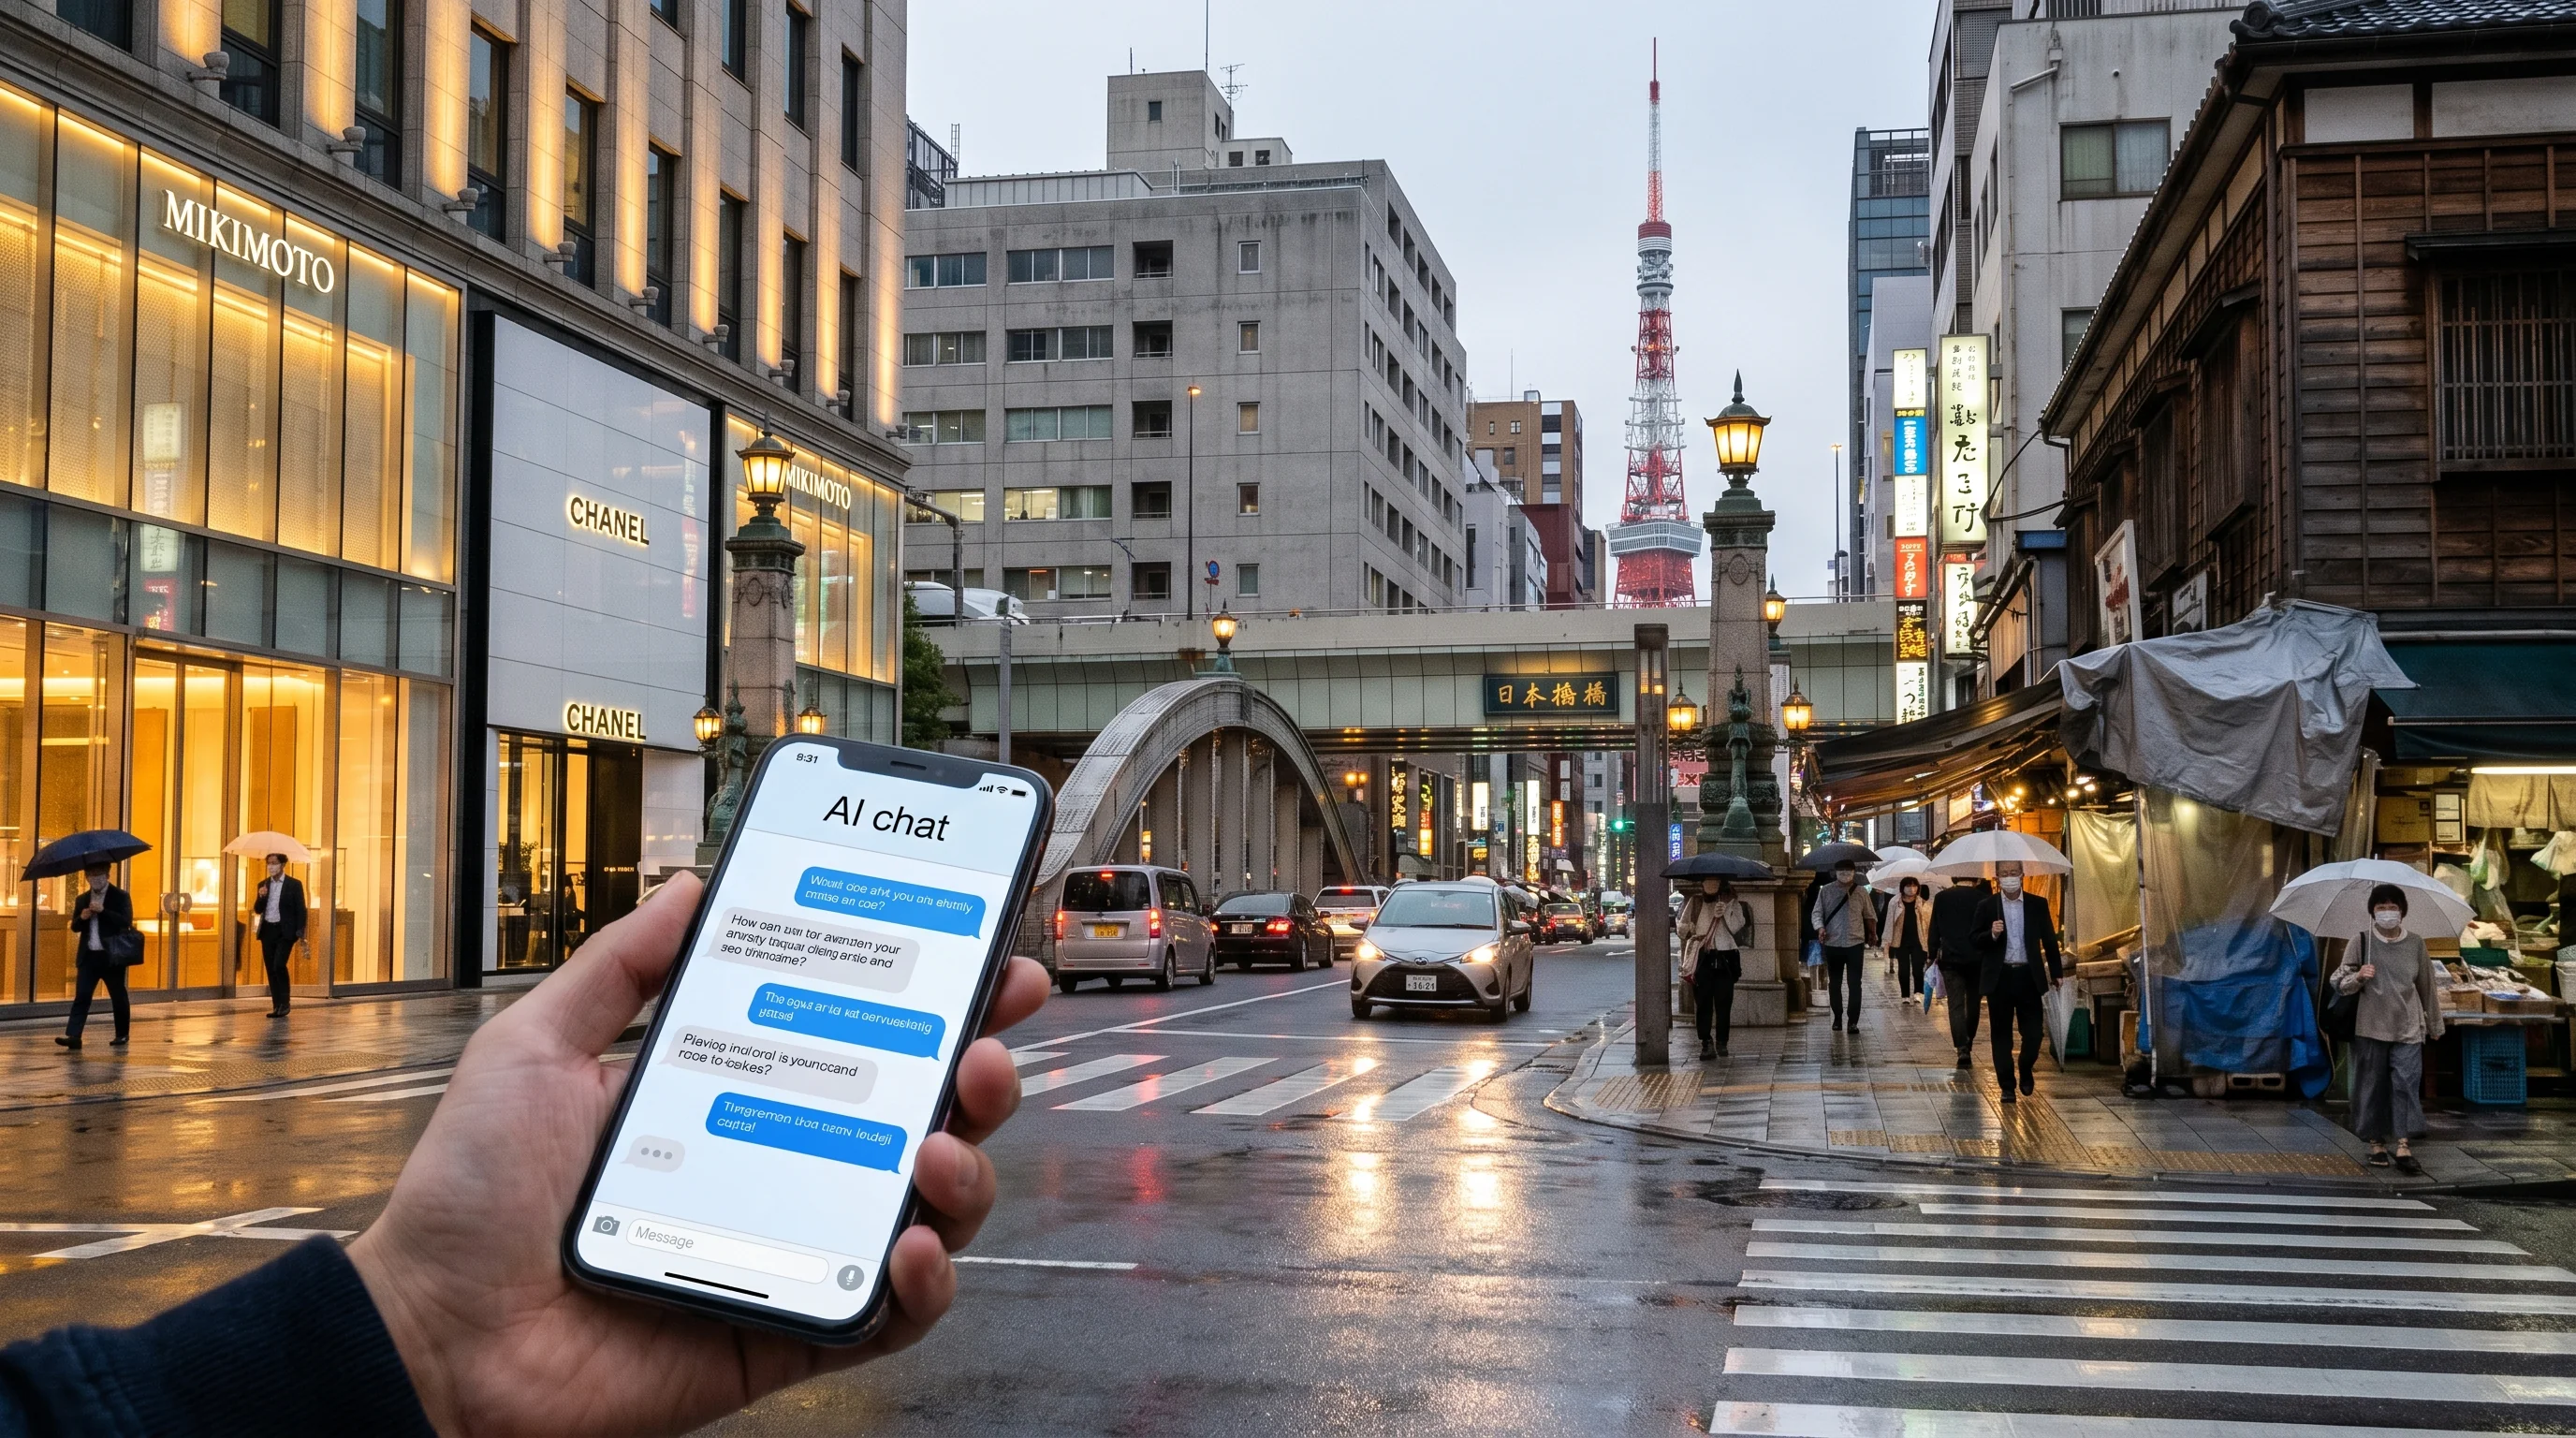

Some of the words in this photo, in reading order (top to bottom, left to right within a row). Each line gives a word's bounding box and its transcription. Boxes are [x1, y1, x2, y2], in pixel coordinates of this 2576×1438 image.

[161, 189, 336, 294] MIKIMOTO
[785, 464, 852, 510] MIKIMOTO
[568, 494, 651, 547] CHANEL
[564, 702, 648, 741] CHANEL
[823, 795, 865, 827] AI
[872, 805, 951, 842] chat
[892, 890, 914, 902] you
[731, 914, 758, 928] How
[873, 942, 901, 955] your
[870, 957, 894, 969] and
[710, 1054, 724, 1066] to
[636, 1225, 694, 1250] Message
